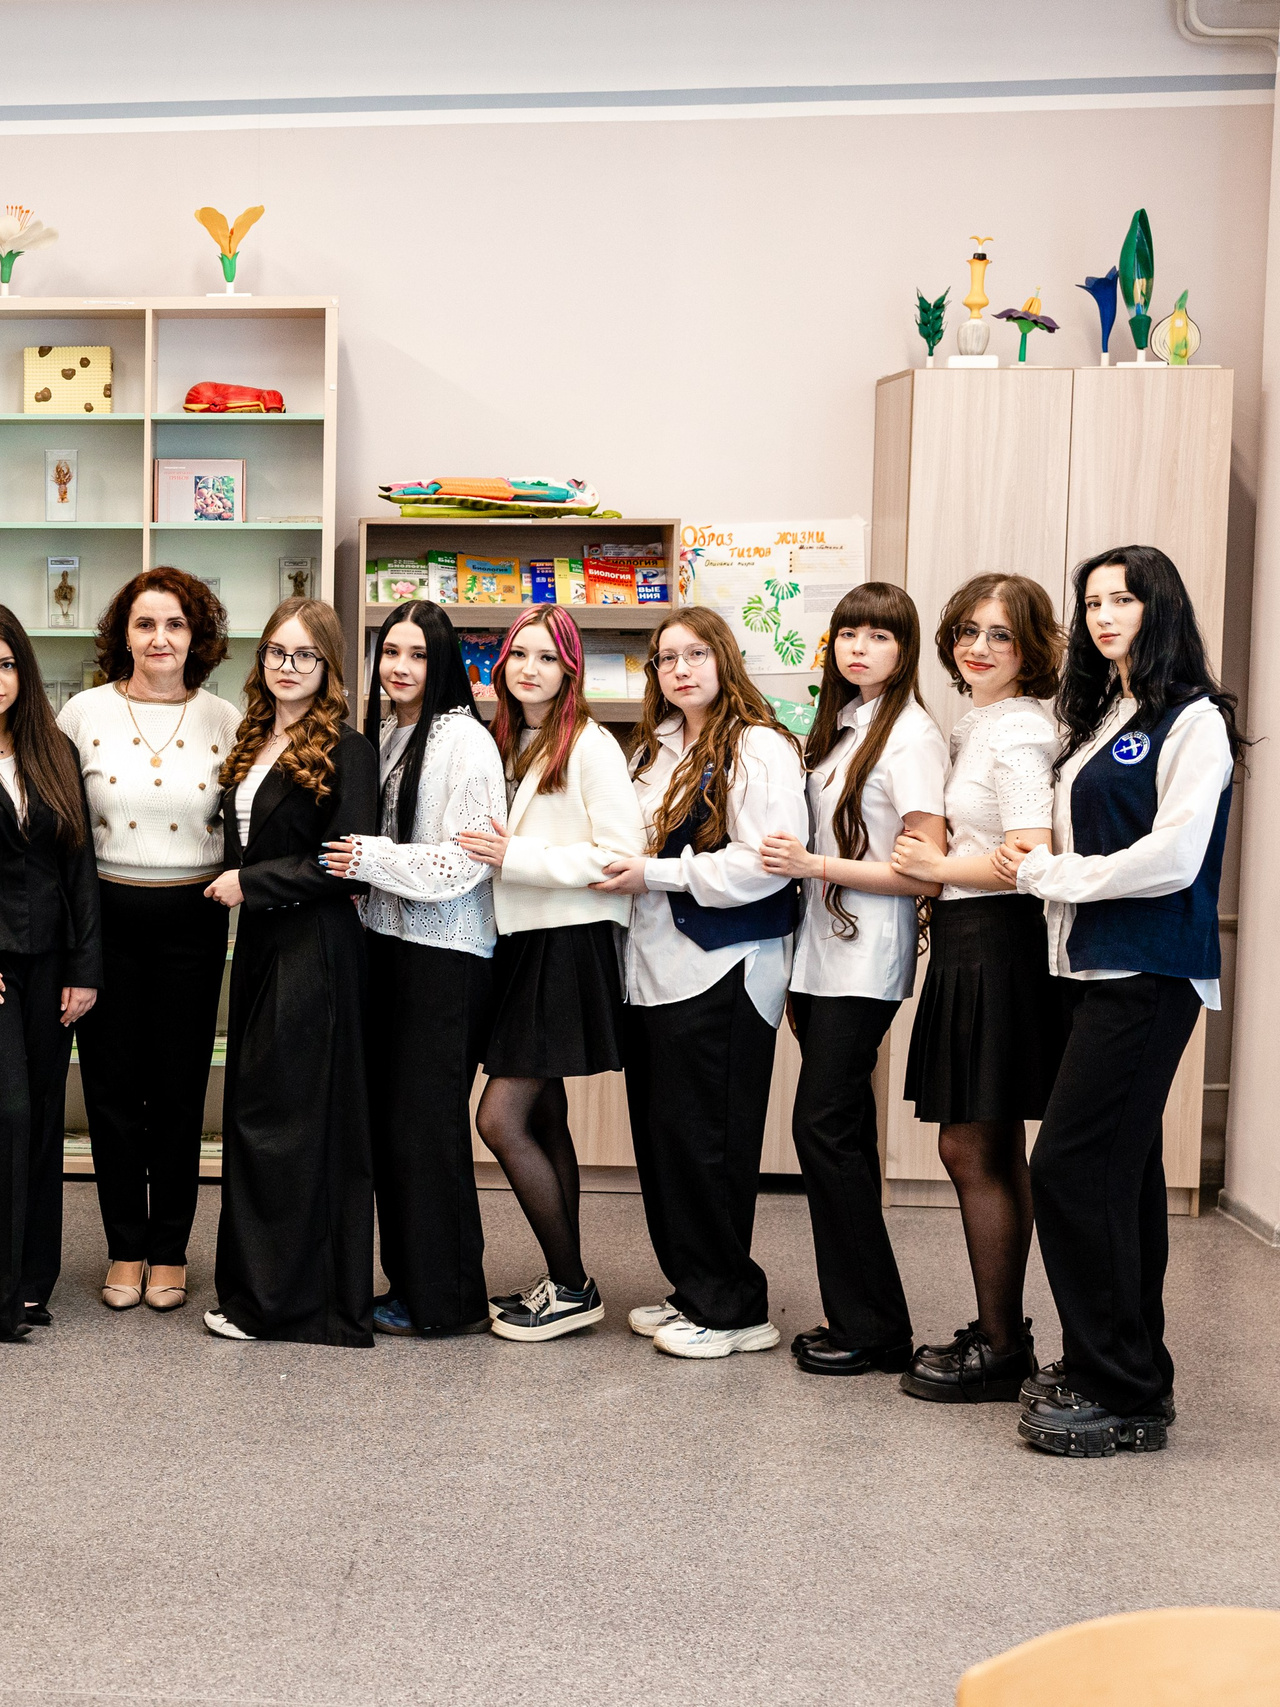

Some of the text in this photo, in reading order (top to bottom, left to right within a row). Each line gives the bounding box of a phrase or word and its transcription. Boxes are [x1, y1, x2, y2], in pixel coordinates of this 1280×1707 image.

[681, 525, 734, 548] Образ
[472, 564, 508, 572] Биология
[588, 568, 631, 580] БИОЛОГИЯ
